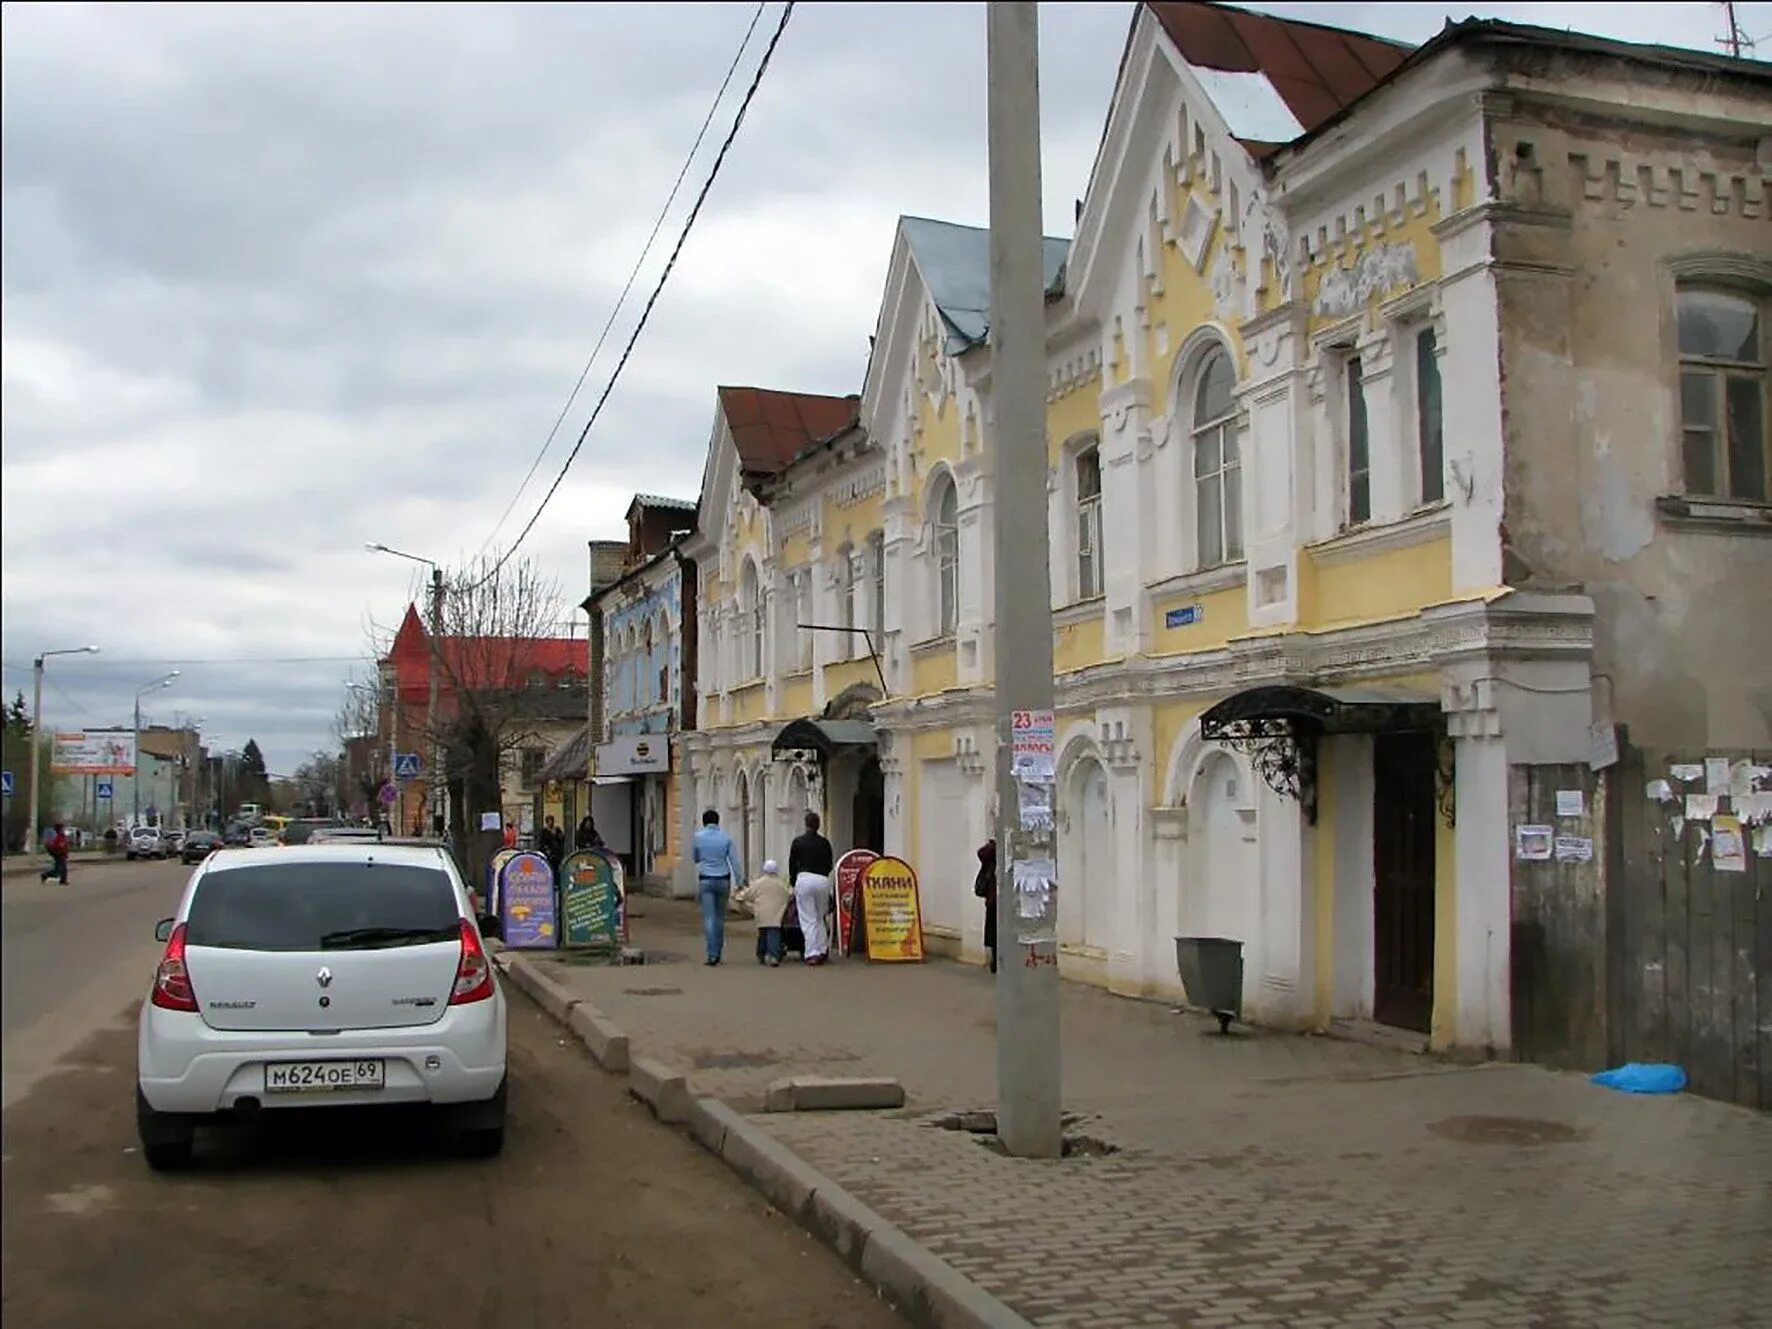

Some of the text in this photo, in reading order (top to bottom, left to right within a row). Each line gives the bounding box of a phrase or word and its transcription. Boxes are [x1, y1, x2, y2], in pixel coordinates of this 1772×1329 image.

[1013, 712, 1031, 729] 23
[866, 876, 913, 889] ТКАНИ
[273, 1063, 376, 1085] М624ОЕ 69
